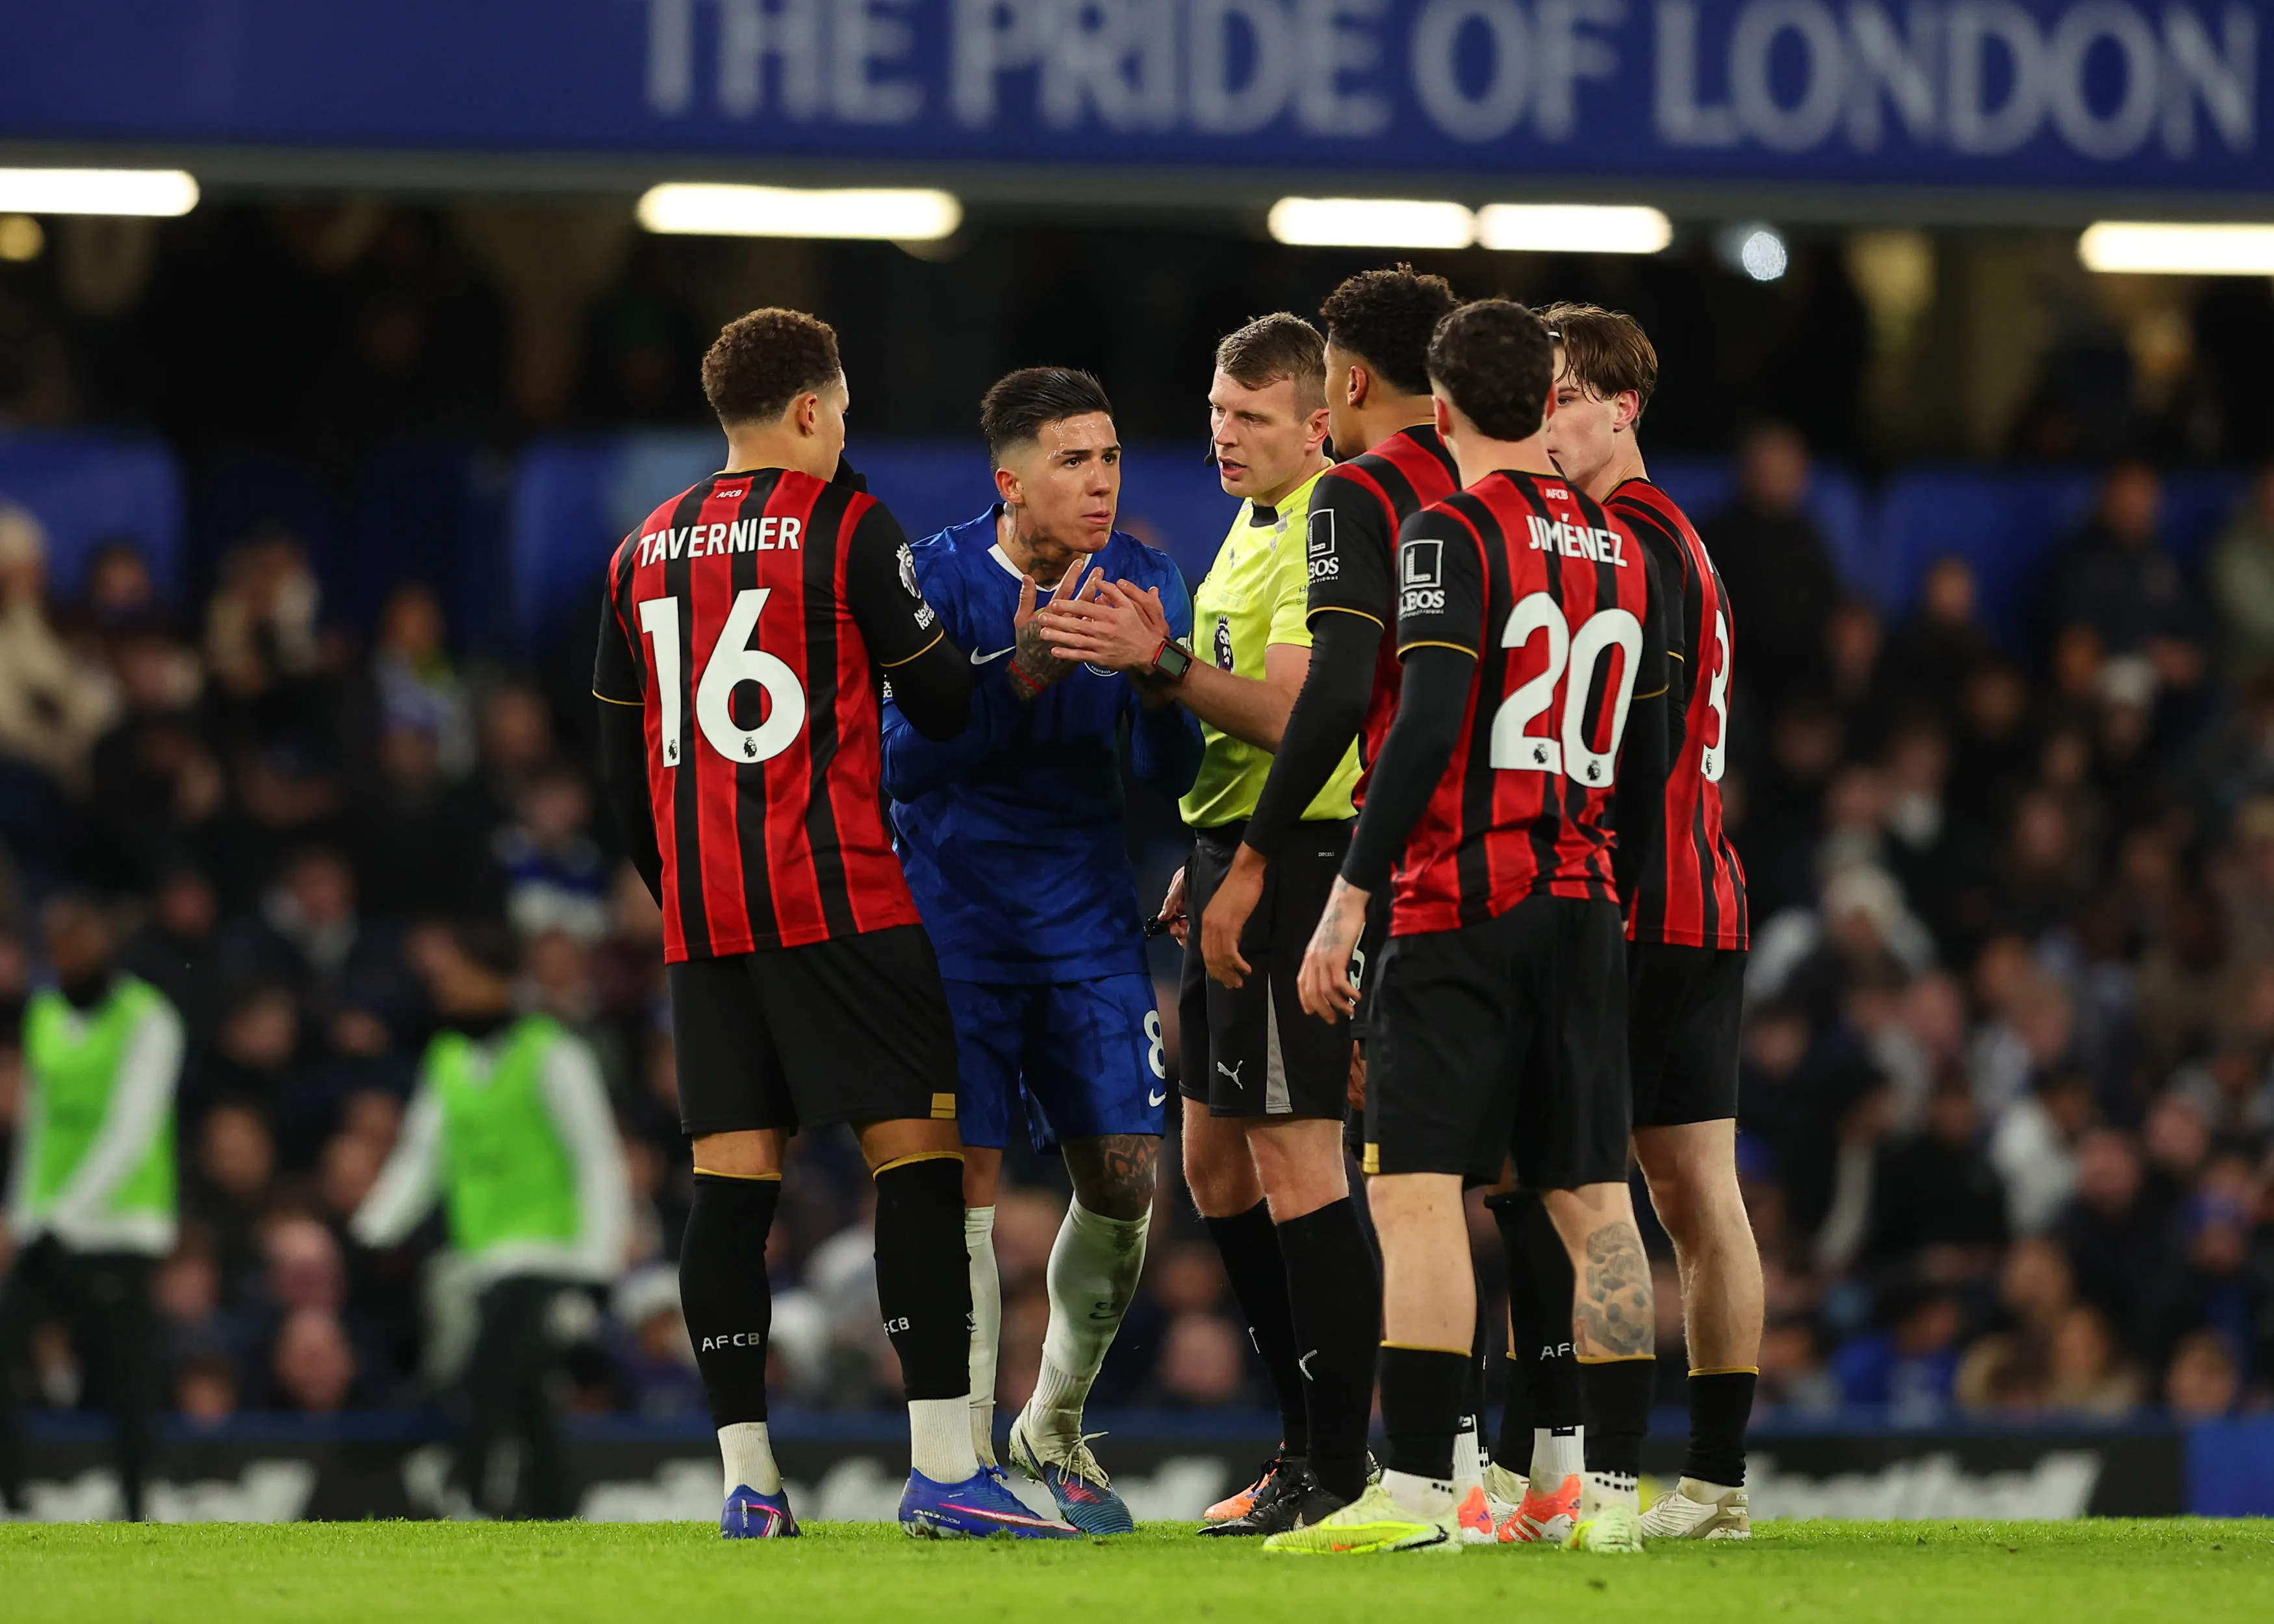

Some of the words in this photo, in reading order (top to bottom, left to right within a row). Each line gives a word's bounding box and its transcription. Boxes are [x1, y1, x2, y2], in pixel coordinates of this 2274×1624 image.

[647, 0, 926, 124] THE
[951, 0, 1392, 135] PRIDE
[1410, 0, 1626, 142] OF
[1652, 0, 2257, 158] LONDON
[715, 489, 743, 499] AFCB
[1545, 488, 1570, 500] AFCB
[639, 516, 802, 568] TAVERNIER
[1525, 512, 1628, 568] JIMÉNEZ
[1309, 557, 1340, 579] EOS
[1398, 589, 1446, 616] LEOS
[638, 587, 806, 768] 16
[1490, 591, 1643, 789] 20
[1143, 1009, 1166, 1080] 8
[702, 1332, 760, 1352] AFCB
